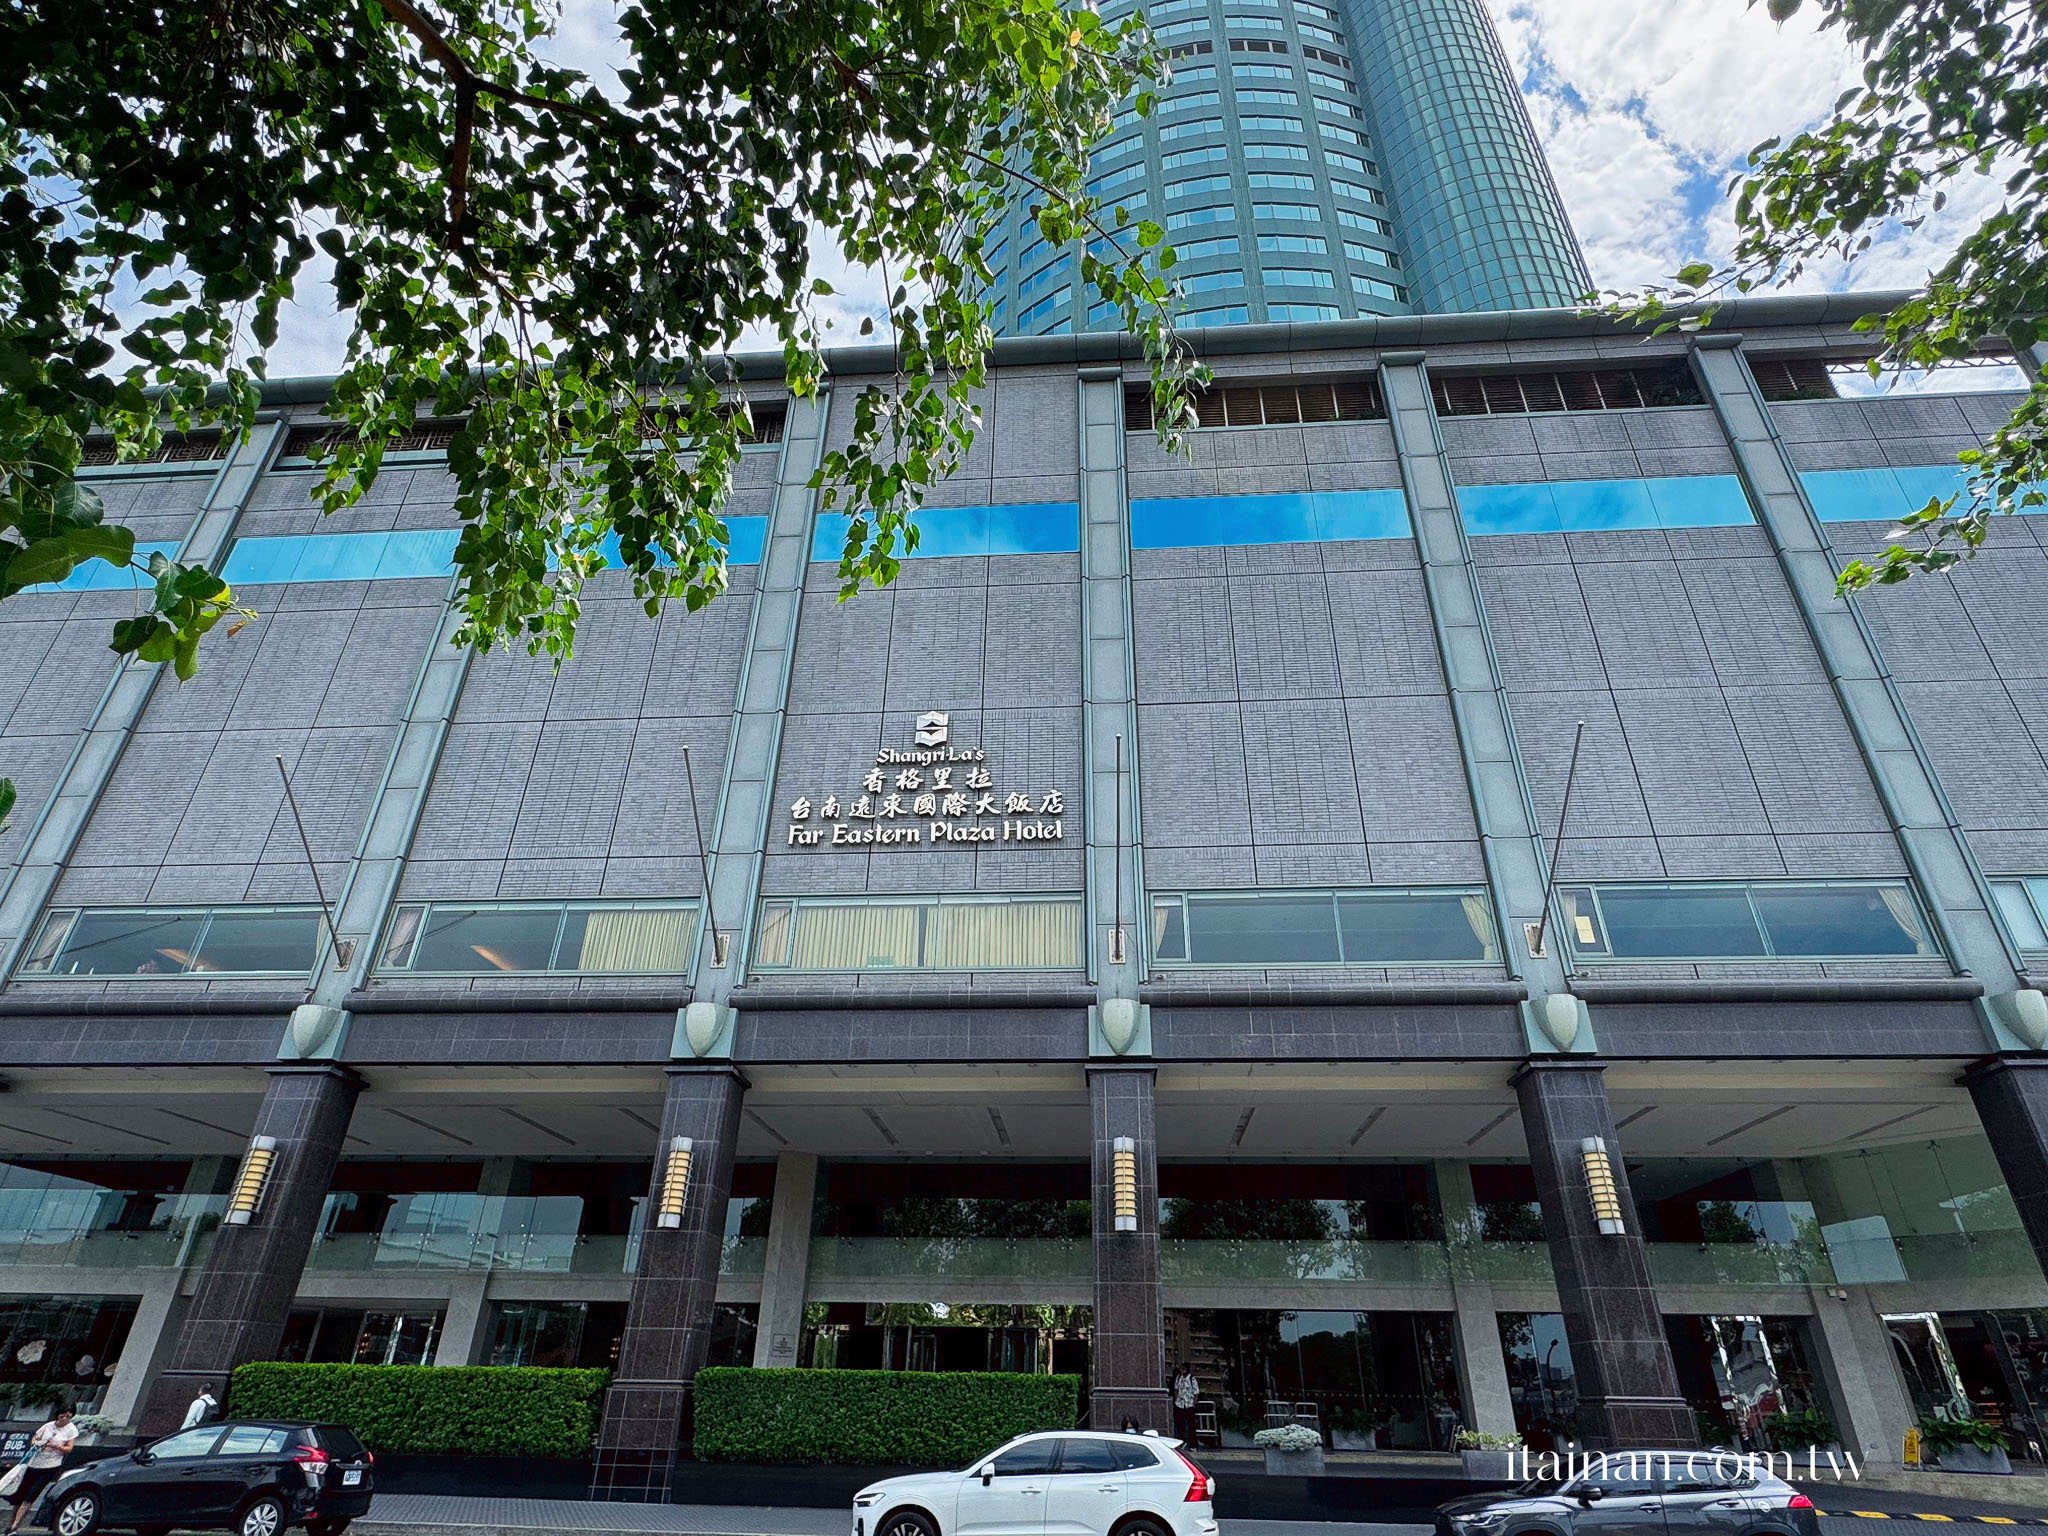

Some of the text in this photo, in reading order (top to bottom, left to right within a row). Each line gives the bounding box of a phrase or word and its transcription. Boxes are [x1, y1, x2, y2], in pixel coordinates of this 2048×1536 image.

[862, 767, 993, 793] 香格里拉
[790, 790, 1064, 820] 台南遠東國際大飯店
[788, 820, 1063, 845] Far Eastern Plaza Hotel
